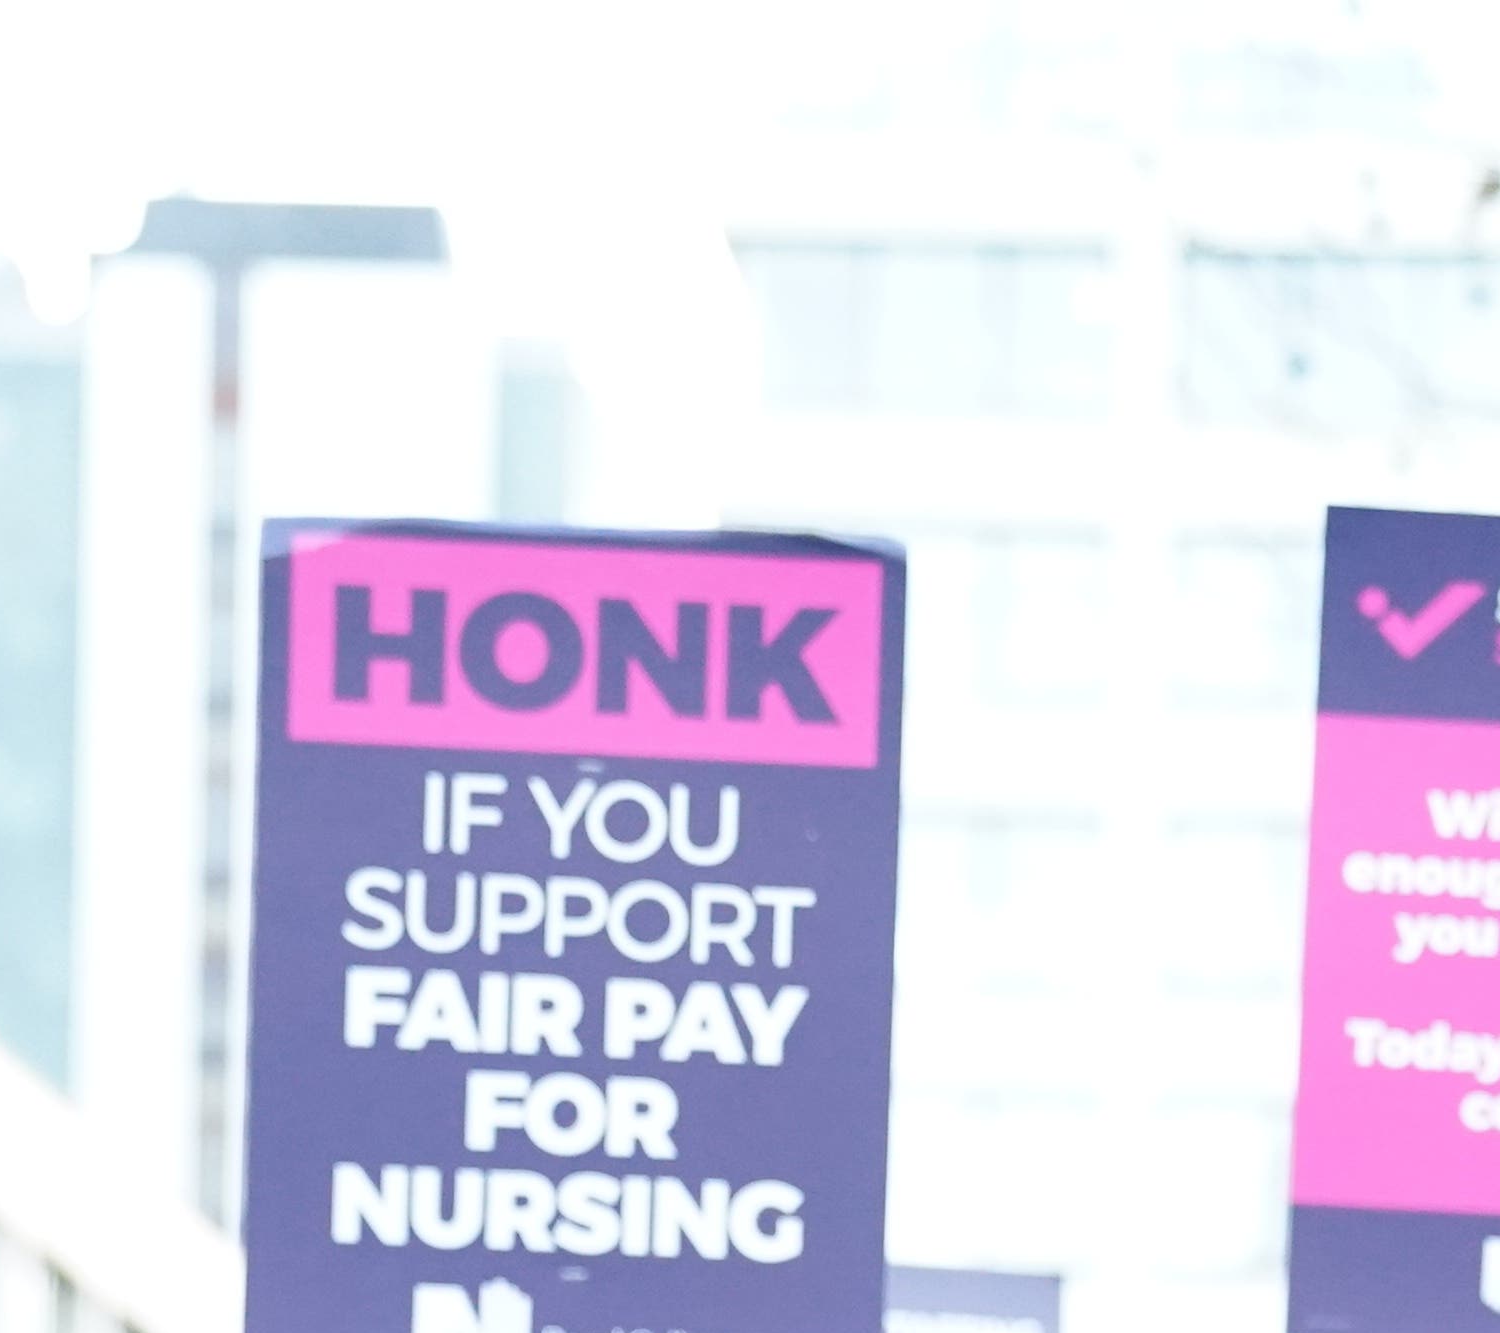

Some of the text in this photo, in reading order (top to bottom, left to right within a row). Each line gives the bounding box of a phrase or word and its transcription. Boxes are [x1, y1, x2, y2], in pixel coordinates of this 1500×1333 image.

[332, 583, 842, 727] HONK
[423, 771, 741, 867] IF YOU
[341, 866, 817, 968] SUPPORT
[1393, 911, 1500, 965] you
[344, 965, 810, 1068] FAIR PAY
[464, 1069, 677, 1160] FOR
[330, 1160, 805, 1264] NURSING
